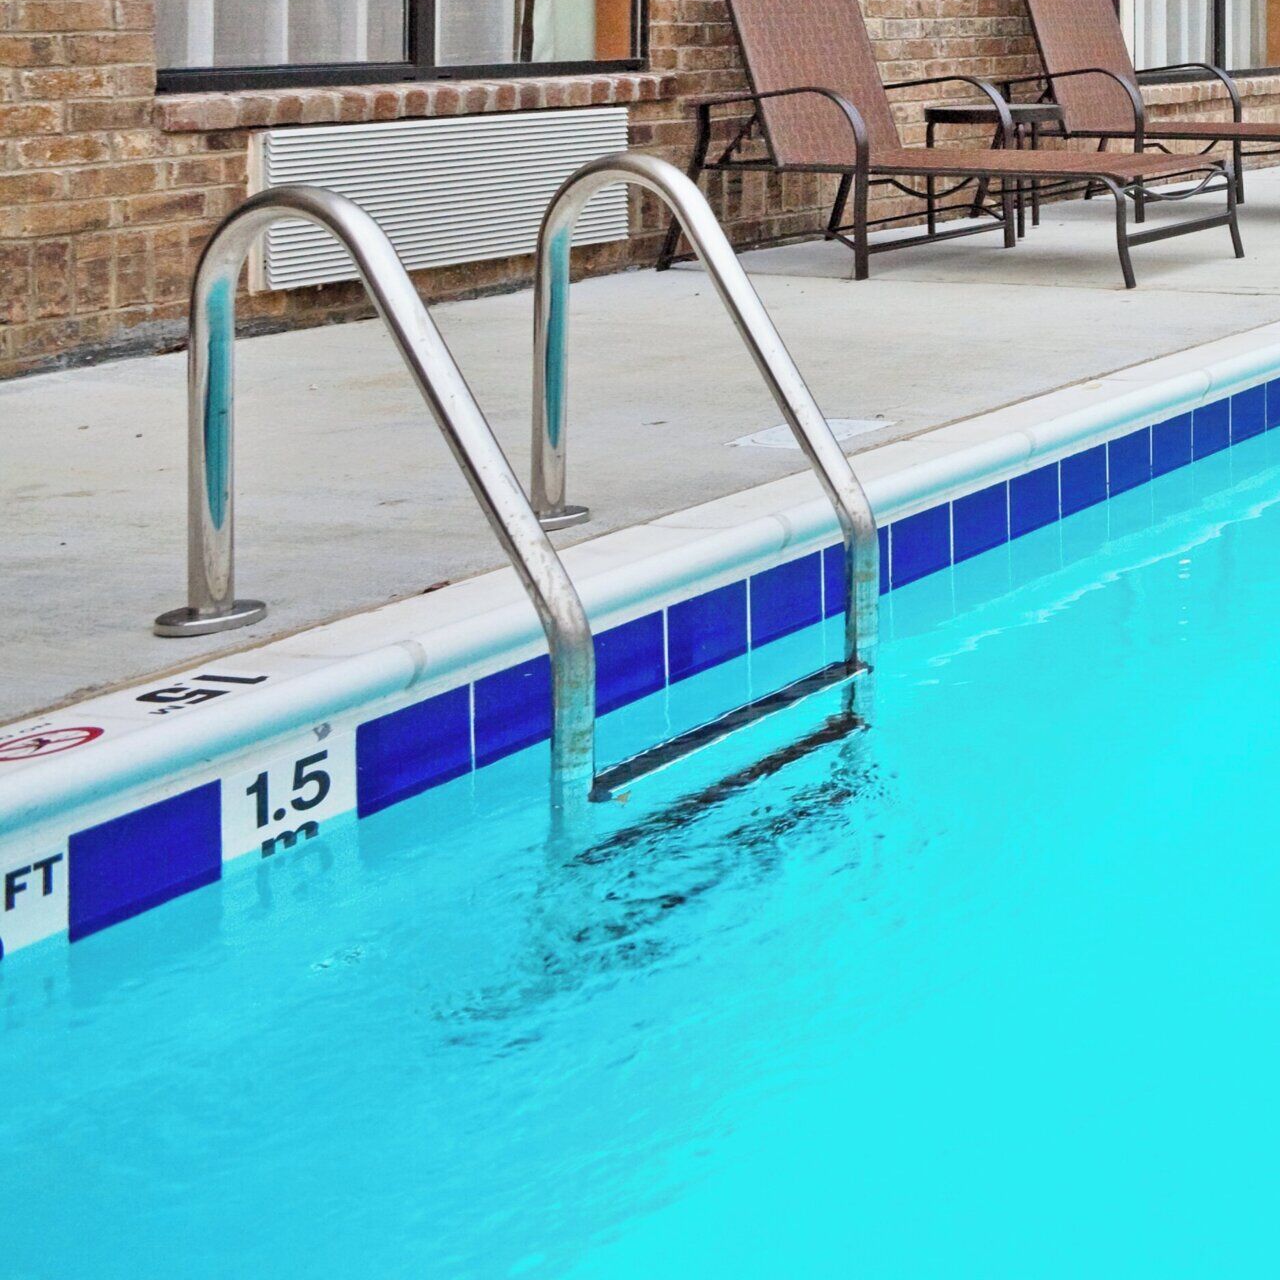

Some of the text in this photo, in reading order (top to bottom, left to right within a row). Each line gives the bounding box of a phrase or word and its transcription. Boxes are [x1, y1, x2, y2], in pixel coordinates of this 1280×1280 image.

[246, 749, 330, 829] 1.5
[261, 821, 319, 859] m
[5, 852, 63, 912] FT
